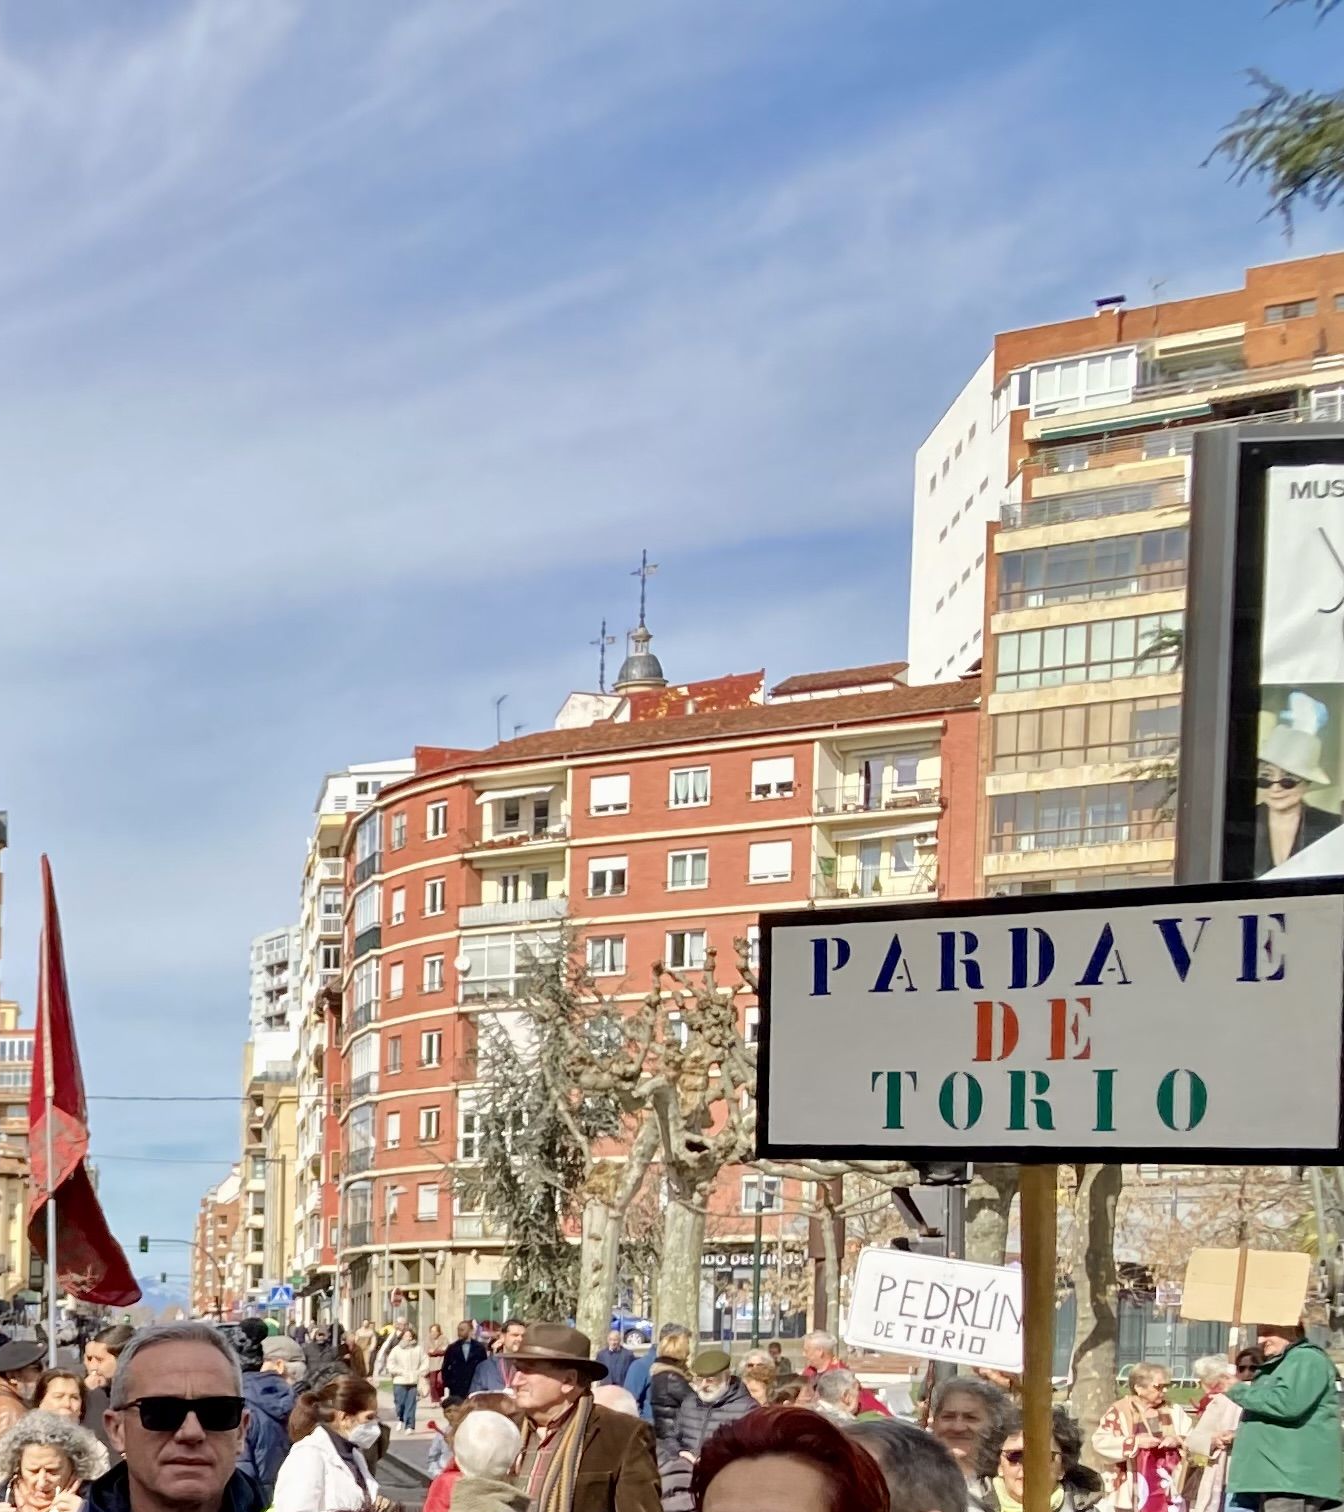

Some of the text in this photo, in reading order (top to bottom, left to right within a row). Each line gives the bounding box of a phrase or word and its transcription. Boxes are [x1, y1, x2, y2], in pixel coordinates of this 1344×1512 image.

[809, 913, 1286, 996] PARDAVE
[972, 998, 1091, 1062] DE
[870, 1069, 1208, 1131] TORIO
[874, 1320, 986, 1354] DE TORIO
